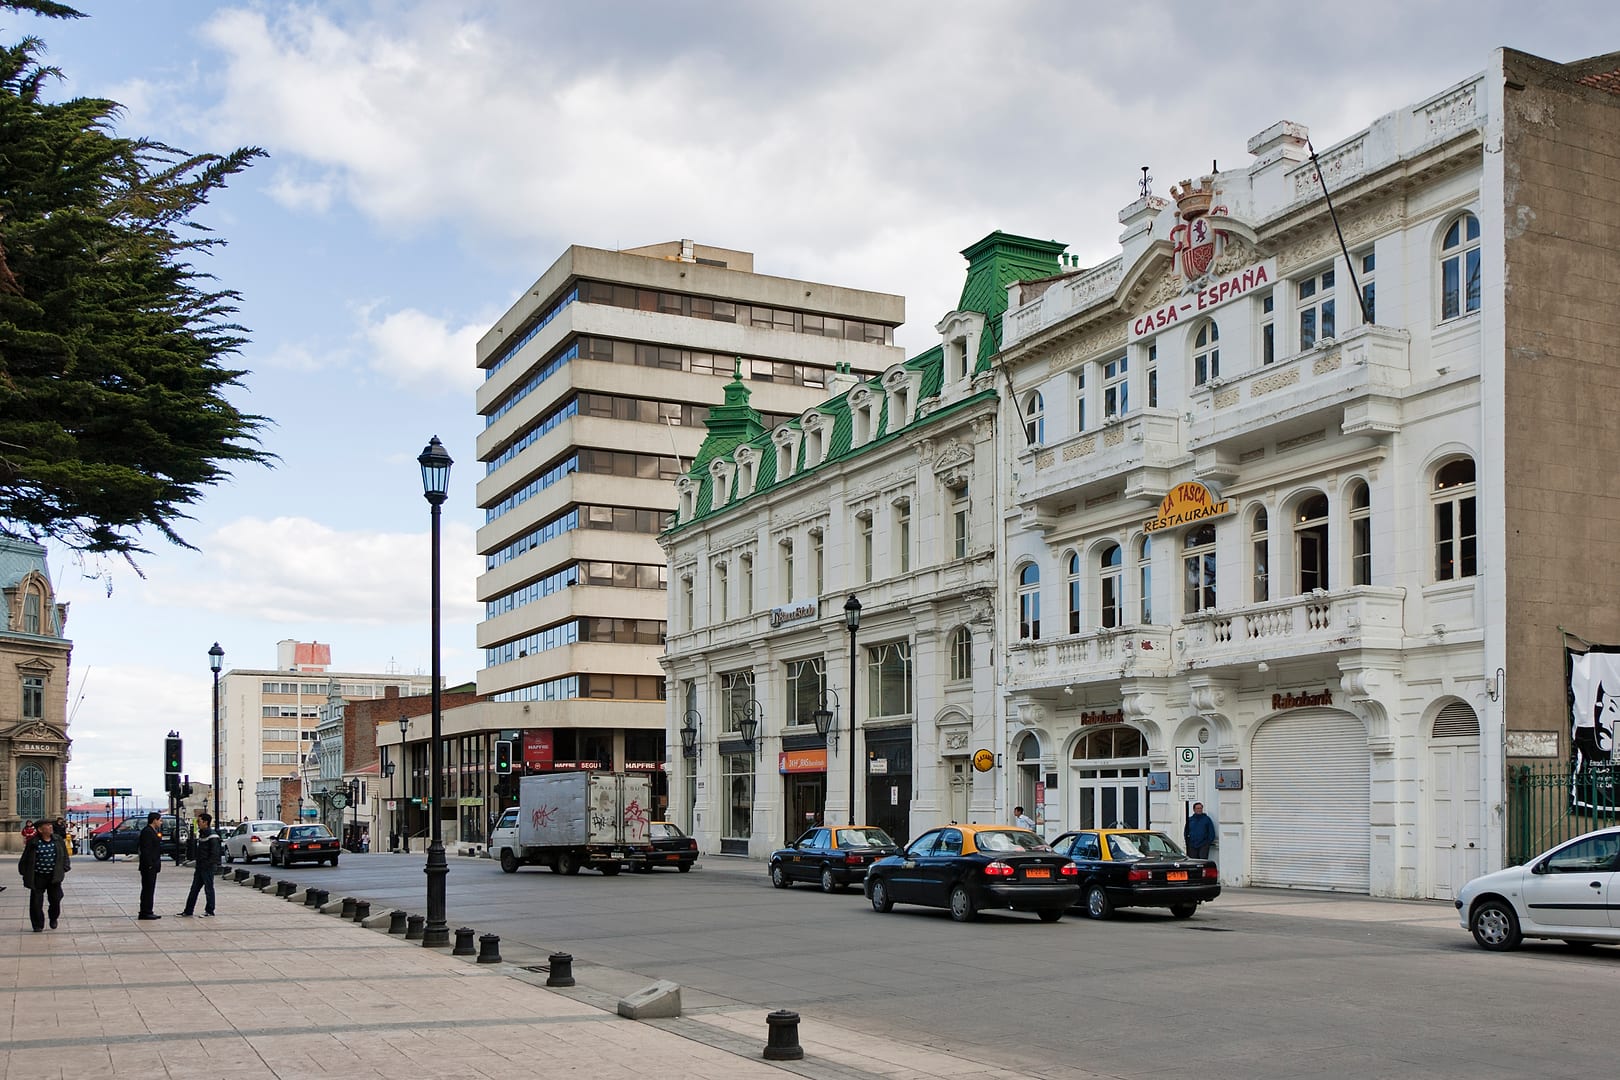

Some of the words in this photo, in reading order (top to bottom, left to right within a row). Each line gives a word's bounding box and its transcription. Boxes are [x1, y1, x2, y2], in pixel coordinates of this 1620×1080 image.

[1134, 305, 1178, 336] CASA
[1197, 265, 1268, 311] ESPAÑA
[1163, 494, 1174, 515] LA
[1178, 485, 1206, 506] TASCA
[1143, 501, 1229, 533] RESTAURANT
[1271, 688, 1333, 710] Rabobank
[1080, 708, 1124, 726] Rabobank
